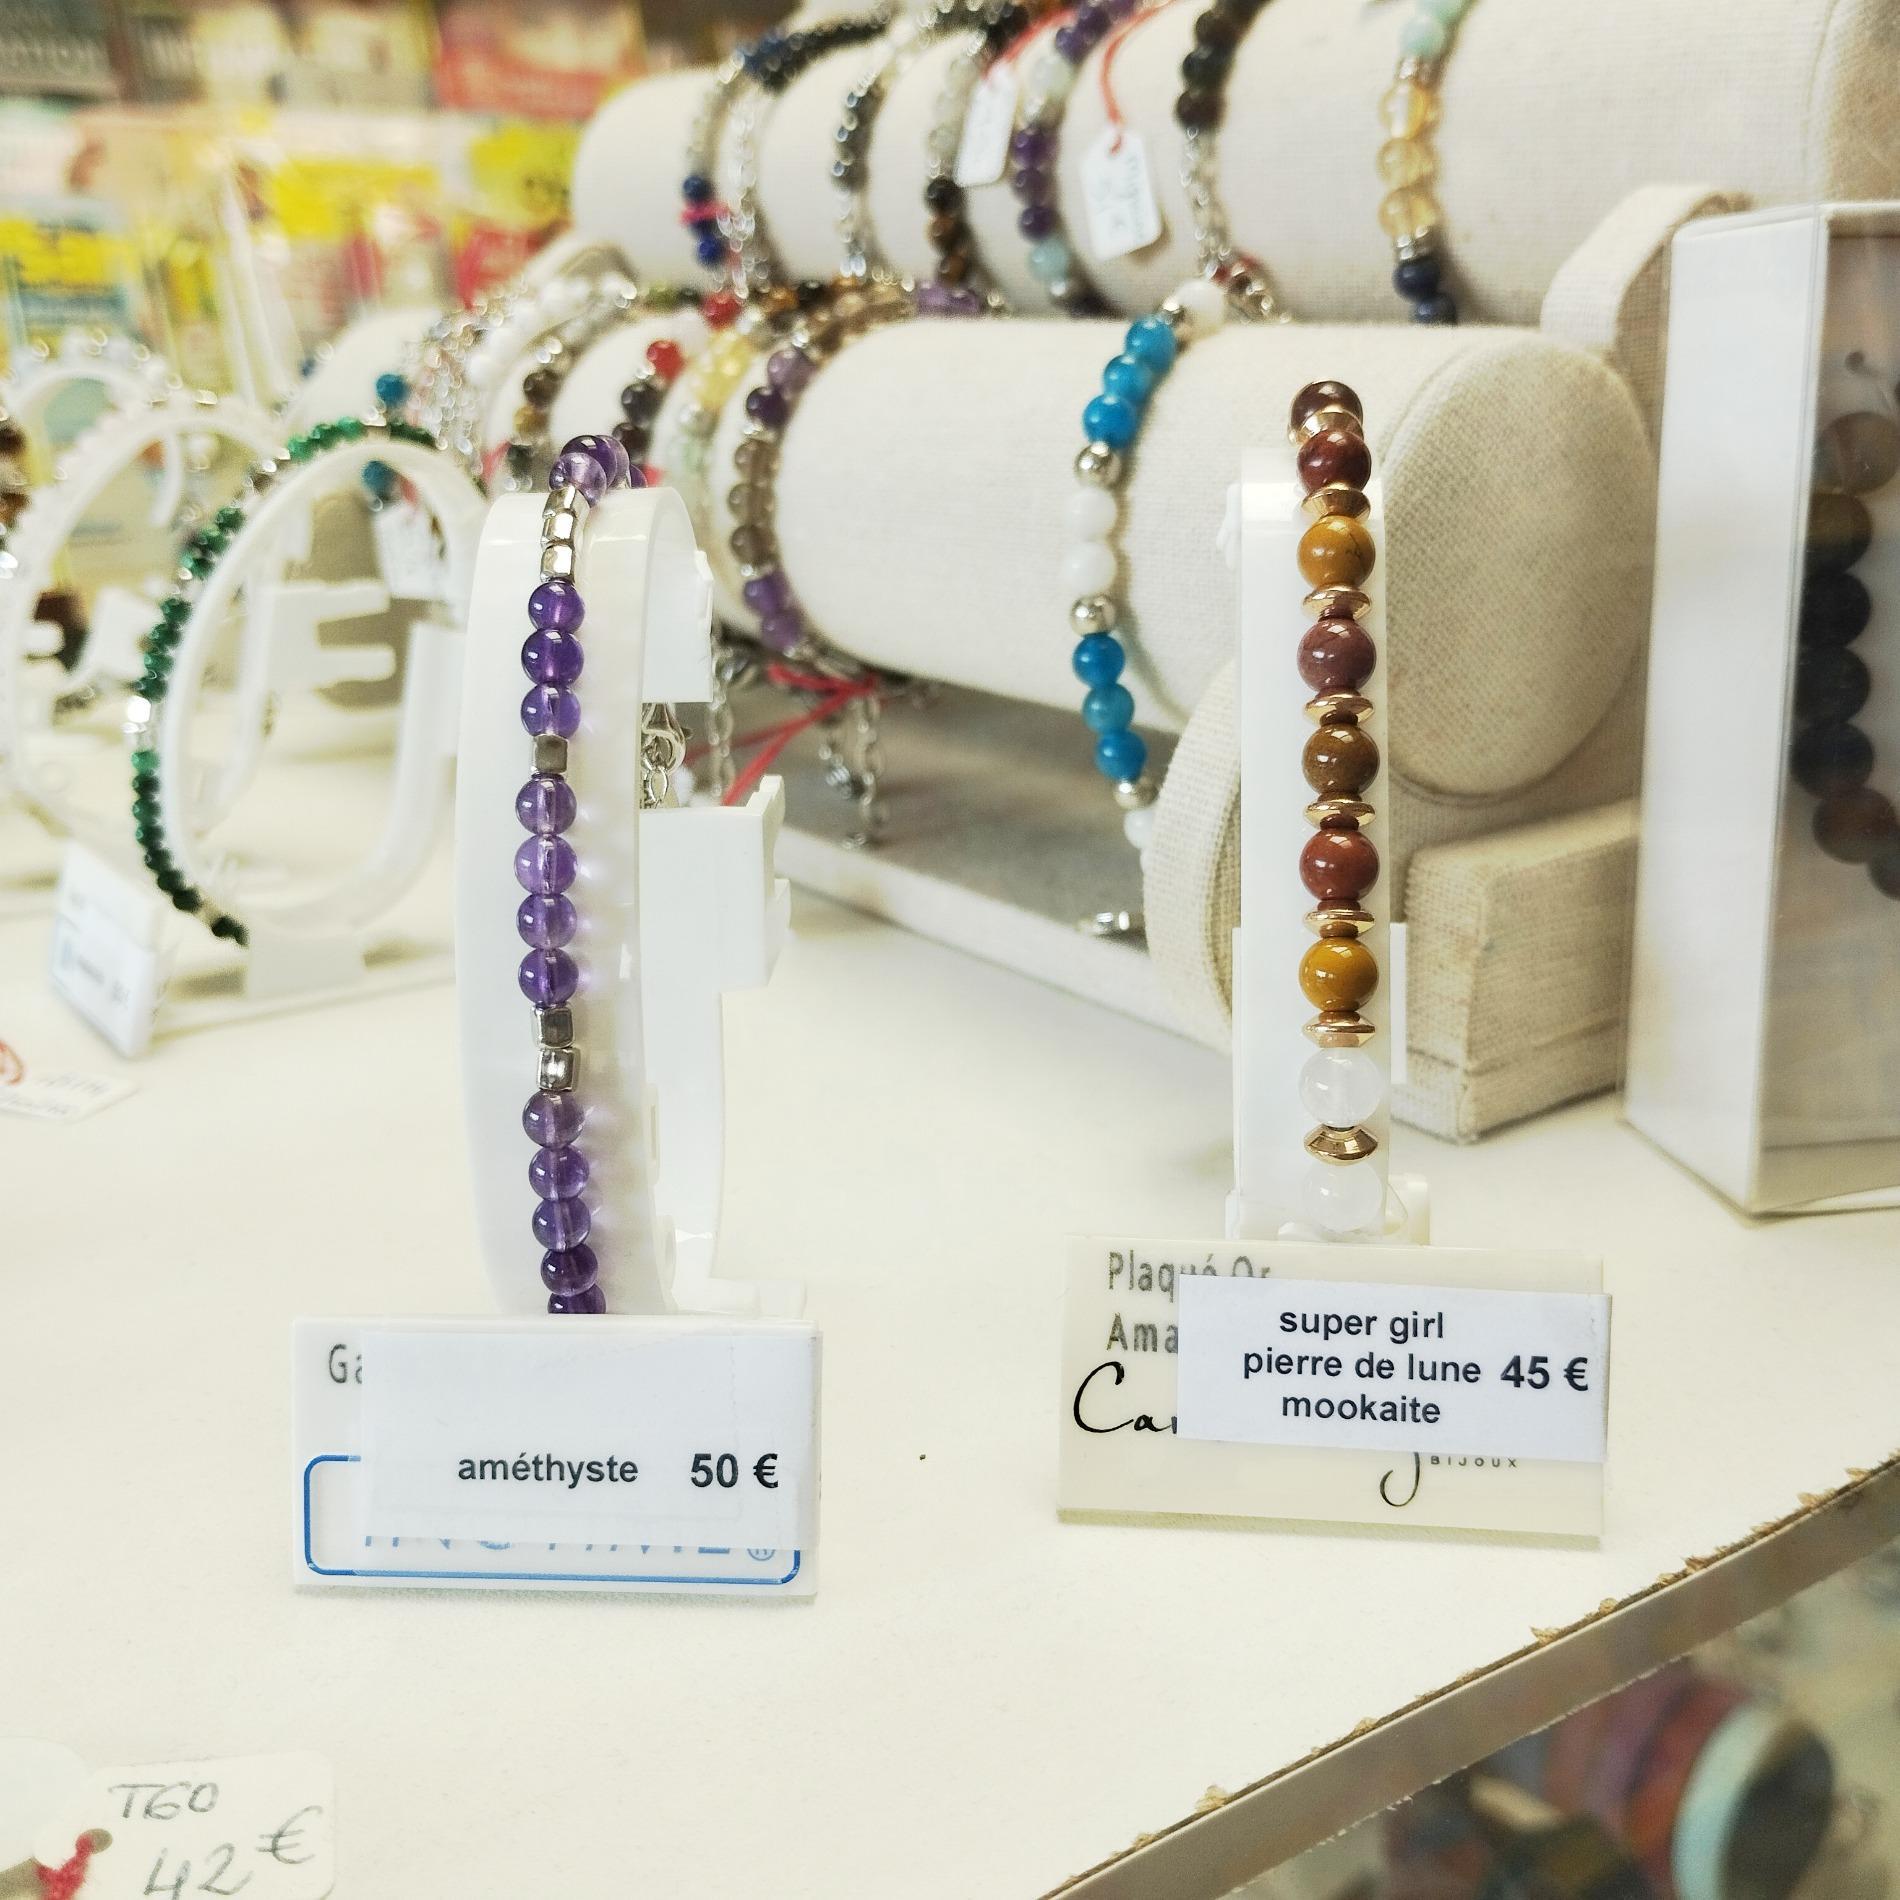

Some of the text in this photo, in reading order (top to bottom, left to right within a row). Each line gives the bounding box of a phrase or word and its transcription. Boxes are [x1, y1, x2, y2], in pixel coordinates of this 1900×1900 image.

[1279, 1311, 1444, 1345] super girl
[1243, 1346, 1589, 1392] pierre de lune 45 €
[1281, 1393, 1441, 1424] mookaite
[457, 1451, 779, 1490] améthyste 50 €
[1430, 1455, 1517, 1468] BIJOUX
[143, 1805, 324, 1900] 42 €
